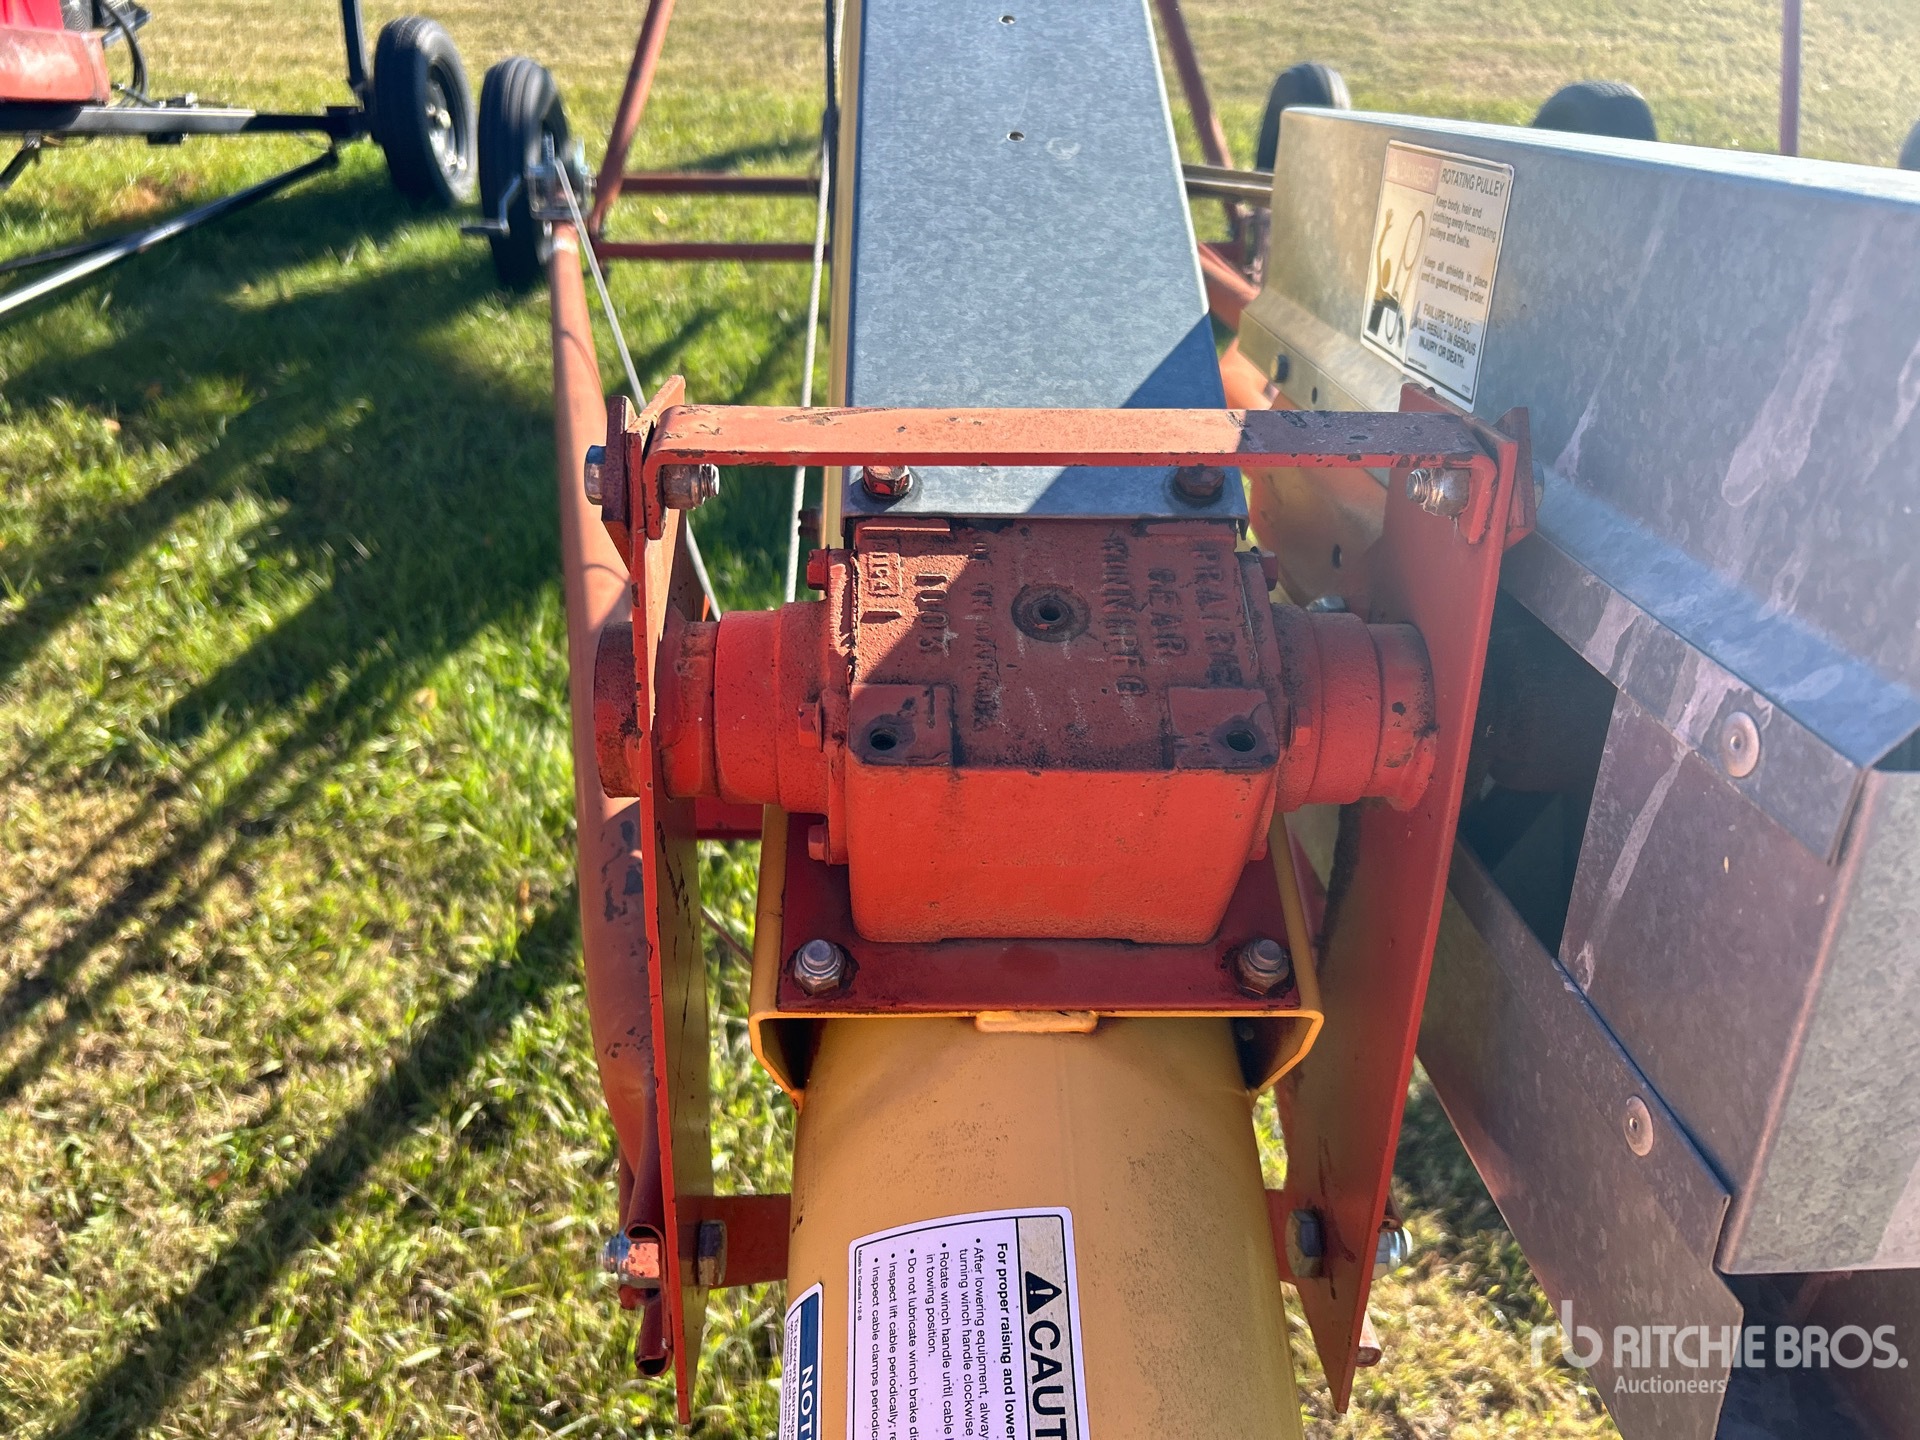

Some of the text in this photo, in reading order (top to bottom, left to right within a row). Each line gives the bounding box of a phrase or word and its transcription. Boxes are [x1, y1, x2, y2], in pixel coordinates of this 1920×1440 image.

[1441, 168, 1504, 196] ROTATING PULLEY
[1436, 196, 1447, 210] Keep
[1462, 203, 1472, 215] hair
[1472, 208, 1482, 218] and
[1429, 227, 1446, 241] pulleys
[1446, 233, 1456, 243] and
[1433, 211, 1496, 243] clothing away from rotating
[1424, 256, 1436, 270] Keep
[1466, 272, 1472, 282] in
[1473, 276, 1488, 288] place
[1449, 283, 1469, 301] working
[1424, 304, 1471, 334] FAILURE TO DO SO
[1419, 336, 1438, 354] INJURY
[1438, 345, 1446, 358] OR
[1427, 322, 1447, 341] RESULT
[1447, 331, 1453, 344] IN
[1453, 335, 1476, 356] SERIOUS
[1146, 568, 1189, 657] GEAR
[1193, 547, 1240, 688] PRAIRIE
[908, 1258, 917, 1274] Do
[940, 1252, 949, 1288] Rotate
[997, 1243, 1008, 1264] For
[871, 1267, 880, 1307] Inspect
[888, 1262, 897, 1303] Inspect
[908, 1277, 917, 1294] not
[996, 1269, 1009, 1314] proper
[889, 1306, 897, 1319] lift
[925, 1254, 936, 1356] in towing position.
[941, 1291, 951, 1325] winch
[872, 1311, 880, 1340] cable
[889, 1322, 898, 1353] cable
[908, 1298, 917, 1347] lubricate
[942, 1329, 952, 1368] handle
[958, 1249, 975, 1436] turning winch handle clockwise
[974, 1247, 990, 1440] After lowering equipment, alway
[1000, 1317, 1012, 1363] raising
[871, 1344, 880, 1386] clamps
[909, 1350, 918, 1385] winch
[1003, 1368, 1015, 1395] and
[1028, 1320, 1067, 1440] CAUT
[887, 1357, 898, 1428] periodically;
[942, 1372, 952, 1397] until
[909, 1389, 918, 1423] brake
[943, 1401, 954, 1434] cable
